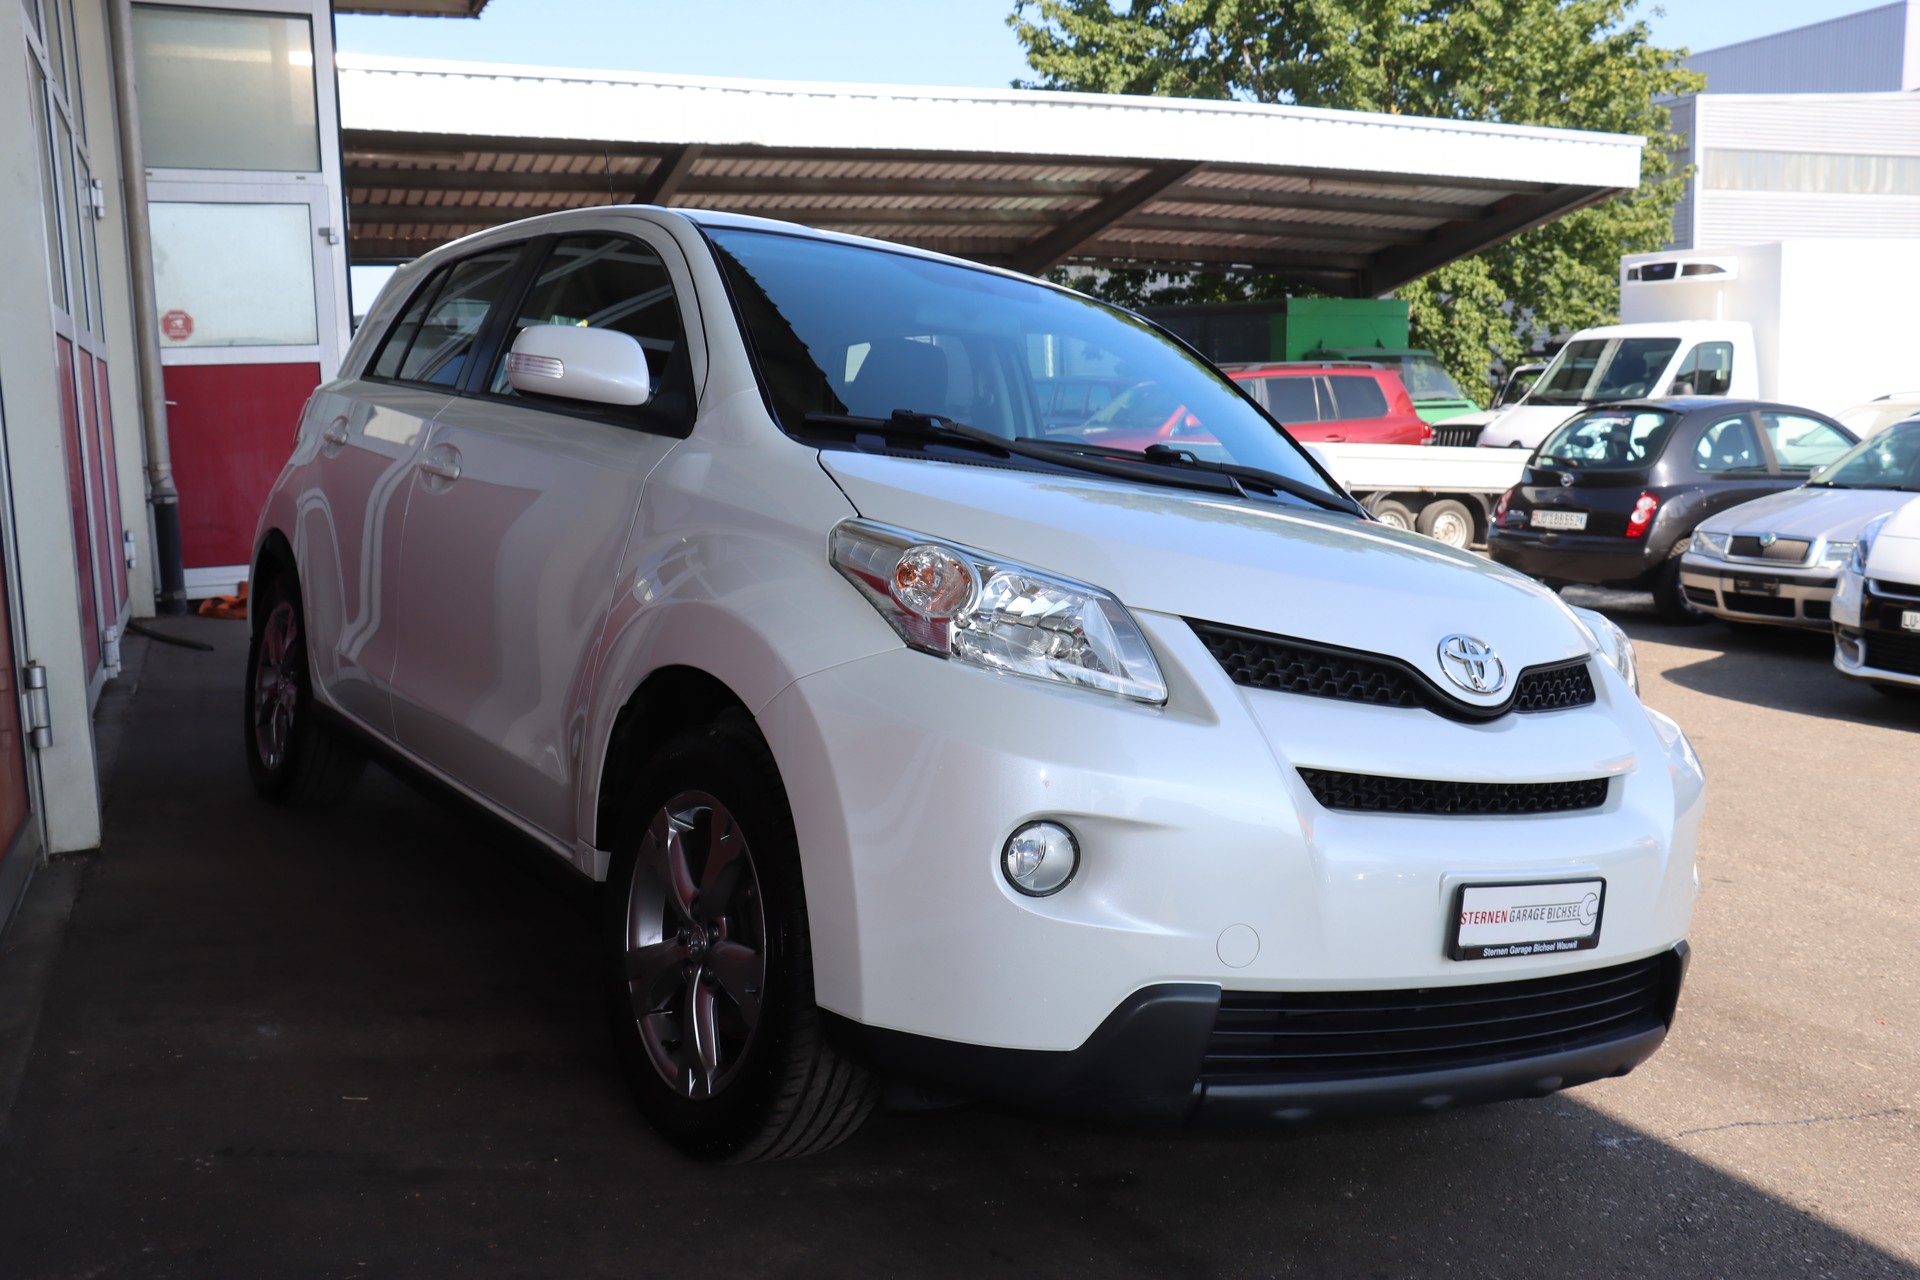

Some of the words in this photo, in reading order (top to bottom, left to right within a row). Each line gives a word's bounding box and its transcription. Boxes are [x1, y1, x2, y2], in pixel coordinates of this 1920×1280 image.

[1460, 911, 1508, 925] STERNEN
[1509, 908, 1545, 922] GARAGE
[1547, 905, 1581, 920] BICHSEL
[1483, 945, 1508, 957] Sternen
[1509, 945, 1532, 955] Garage
[1533, 942, 1555, 952] Bichsel
[1556, 941, 1578, 950] Wauwil
